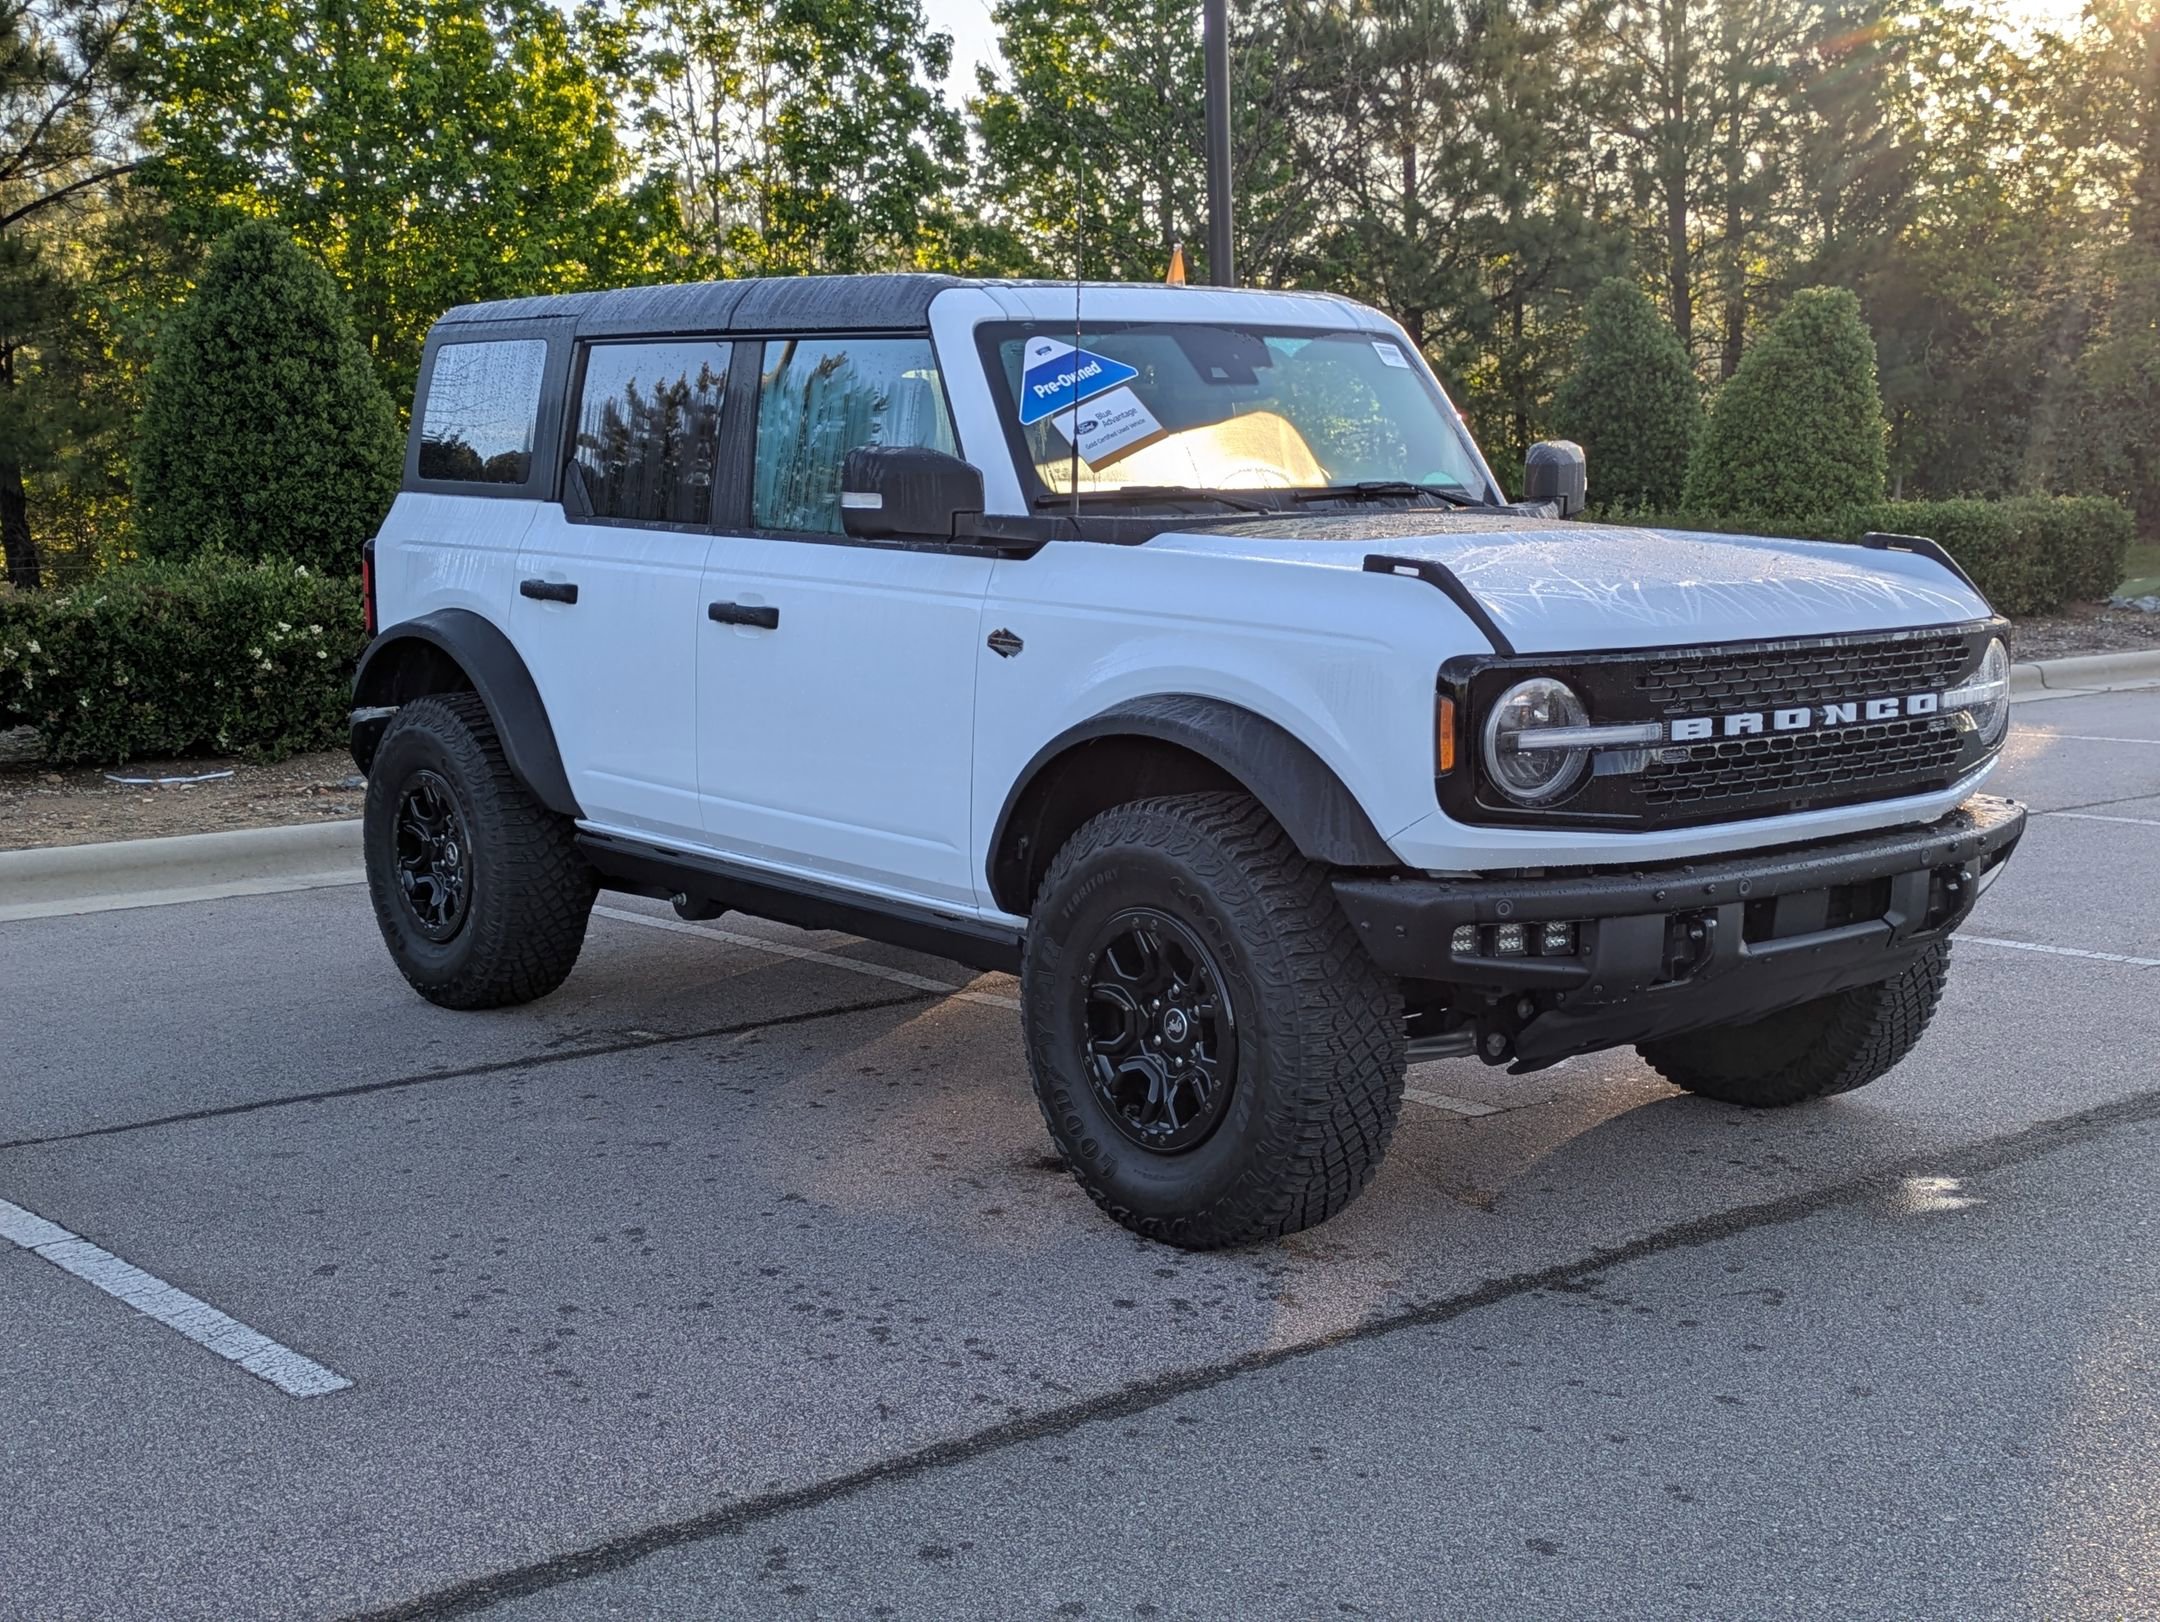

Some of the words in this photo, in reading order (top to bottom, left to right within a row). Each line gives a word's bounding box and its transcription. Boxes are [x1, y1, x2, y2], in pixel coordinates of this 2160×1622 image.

[1032, 360, 1103, 399] Pre-Owned
[1095, 409, 1113, 421] Blue
[1101, 407, 1138, 428] Advantage
[1085, 440, 1098, 450] Gold
[1097, 430, 1118, 444] Certified
[1671, 693, 1939, 742] BRONCO
